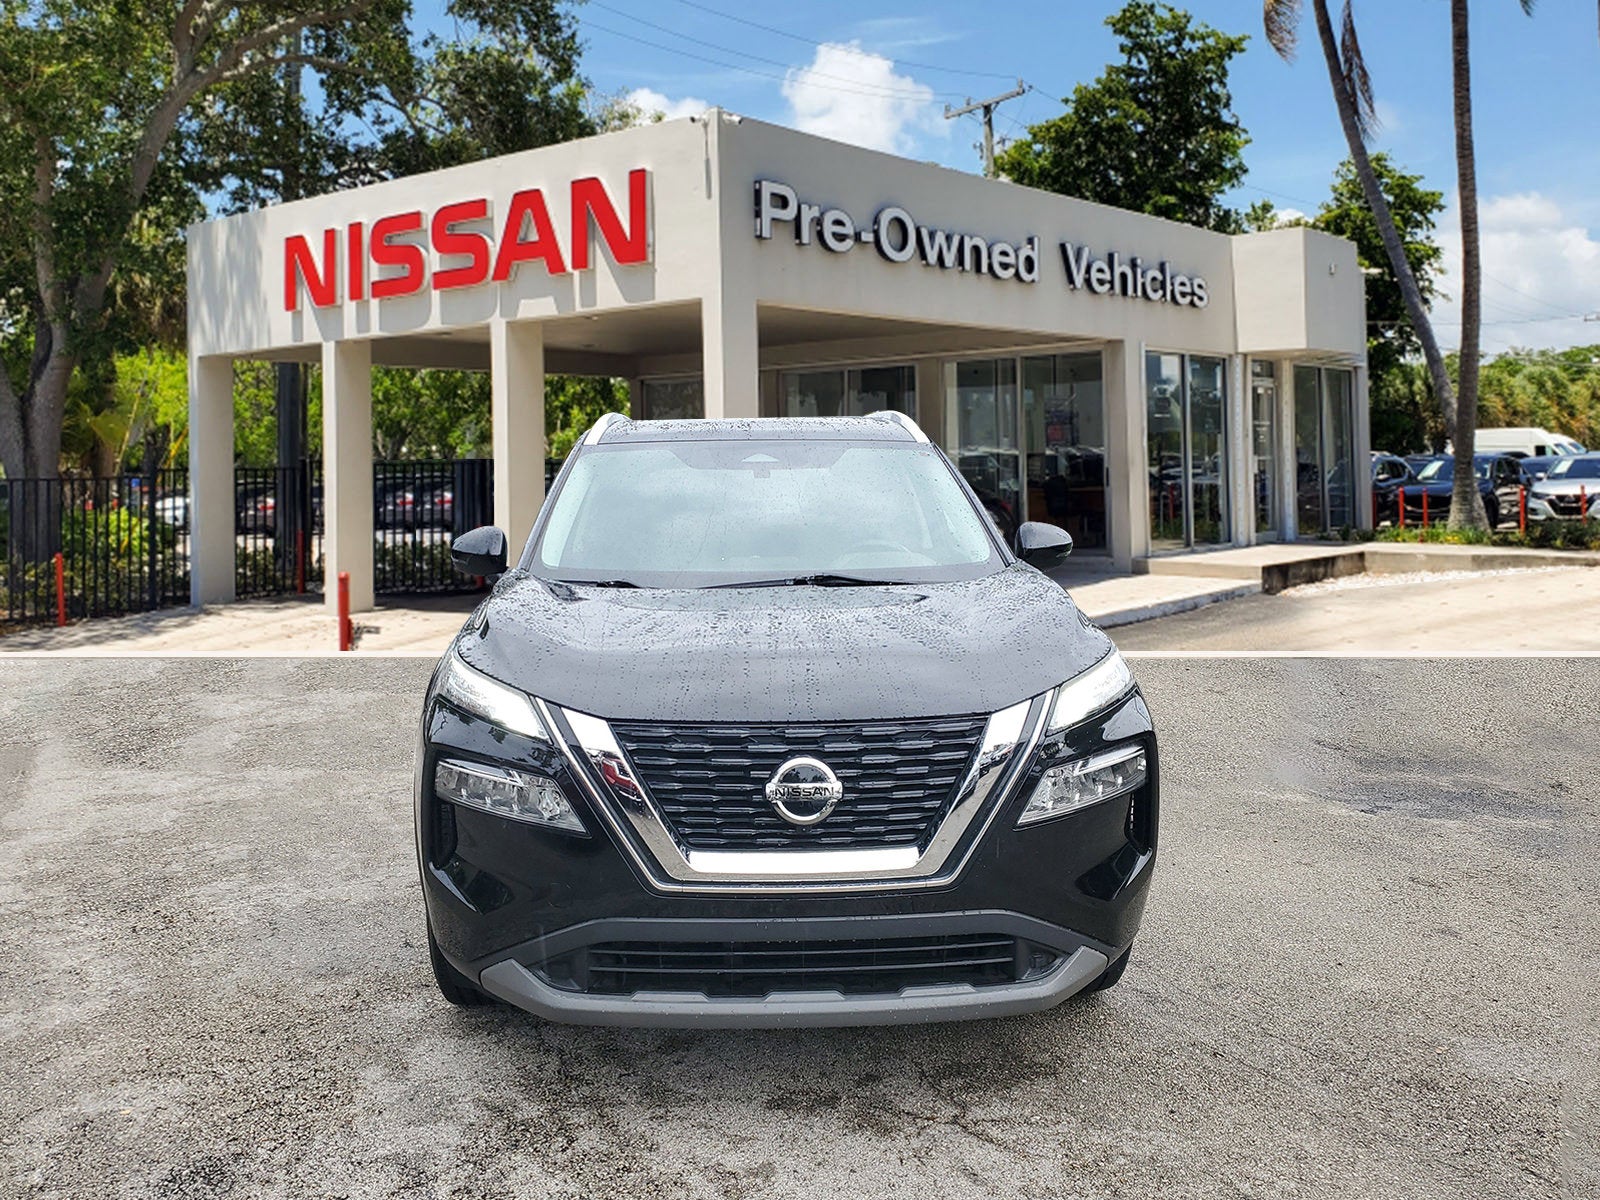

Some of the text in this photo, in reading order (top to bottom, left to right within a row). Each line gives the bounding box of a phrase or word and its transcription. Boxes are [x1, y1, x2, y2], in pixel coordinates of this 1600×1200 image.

[285, 169, 647, 311] NISSAN
[755, 180, 1208, 308] Pre-Owned Vehicles
[773, 786, 834, 798] NISSAN
